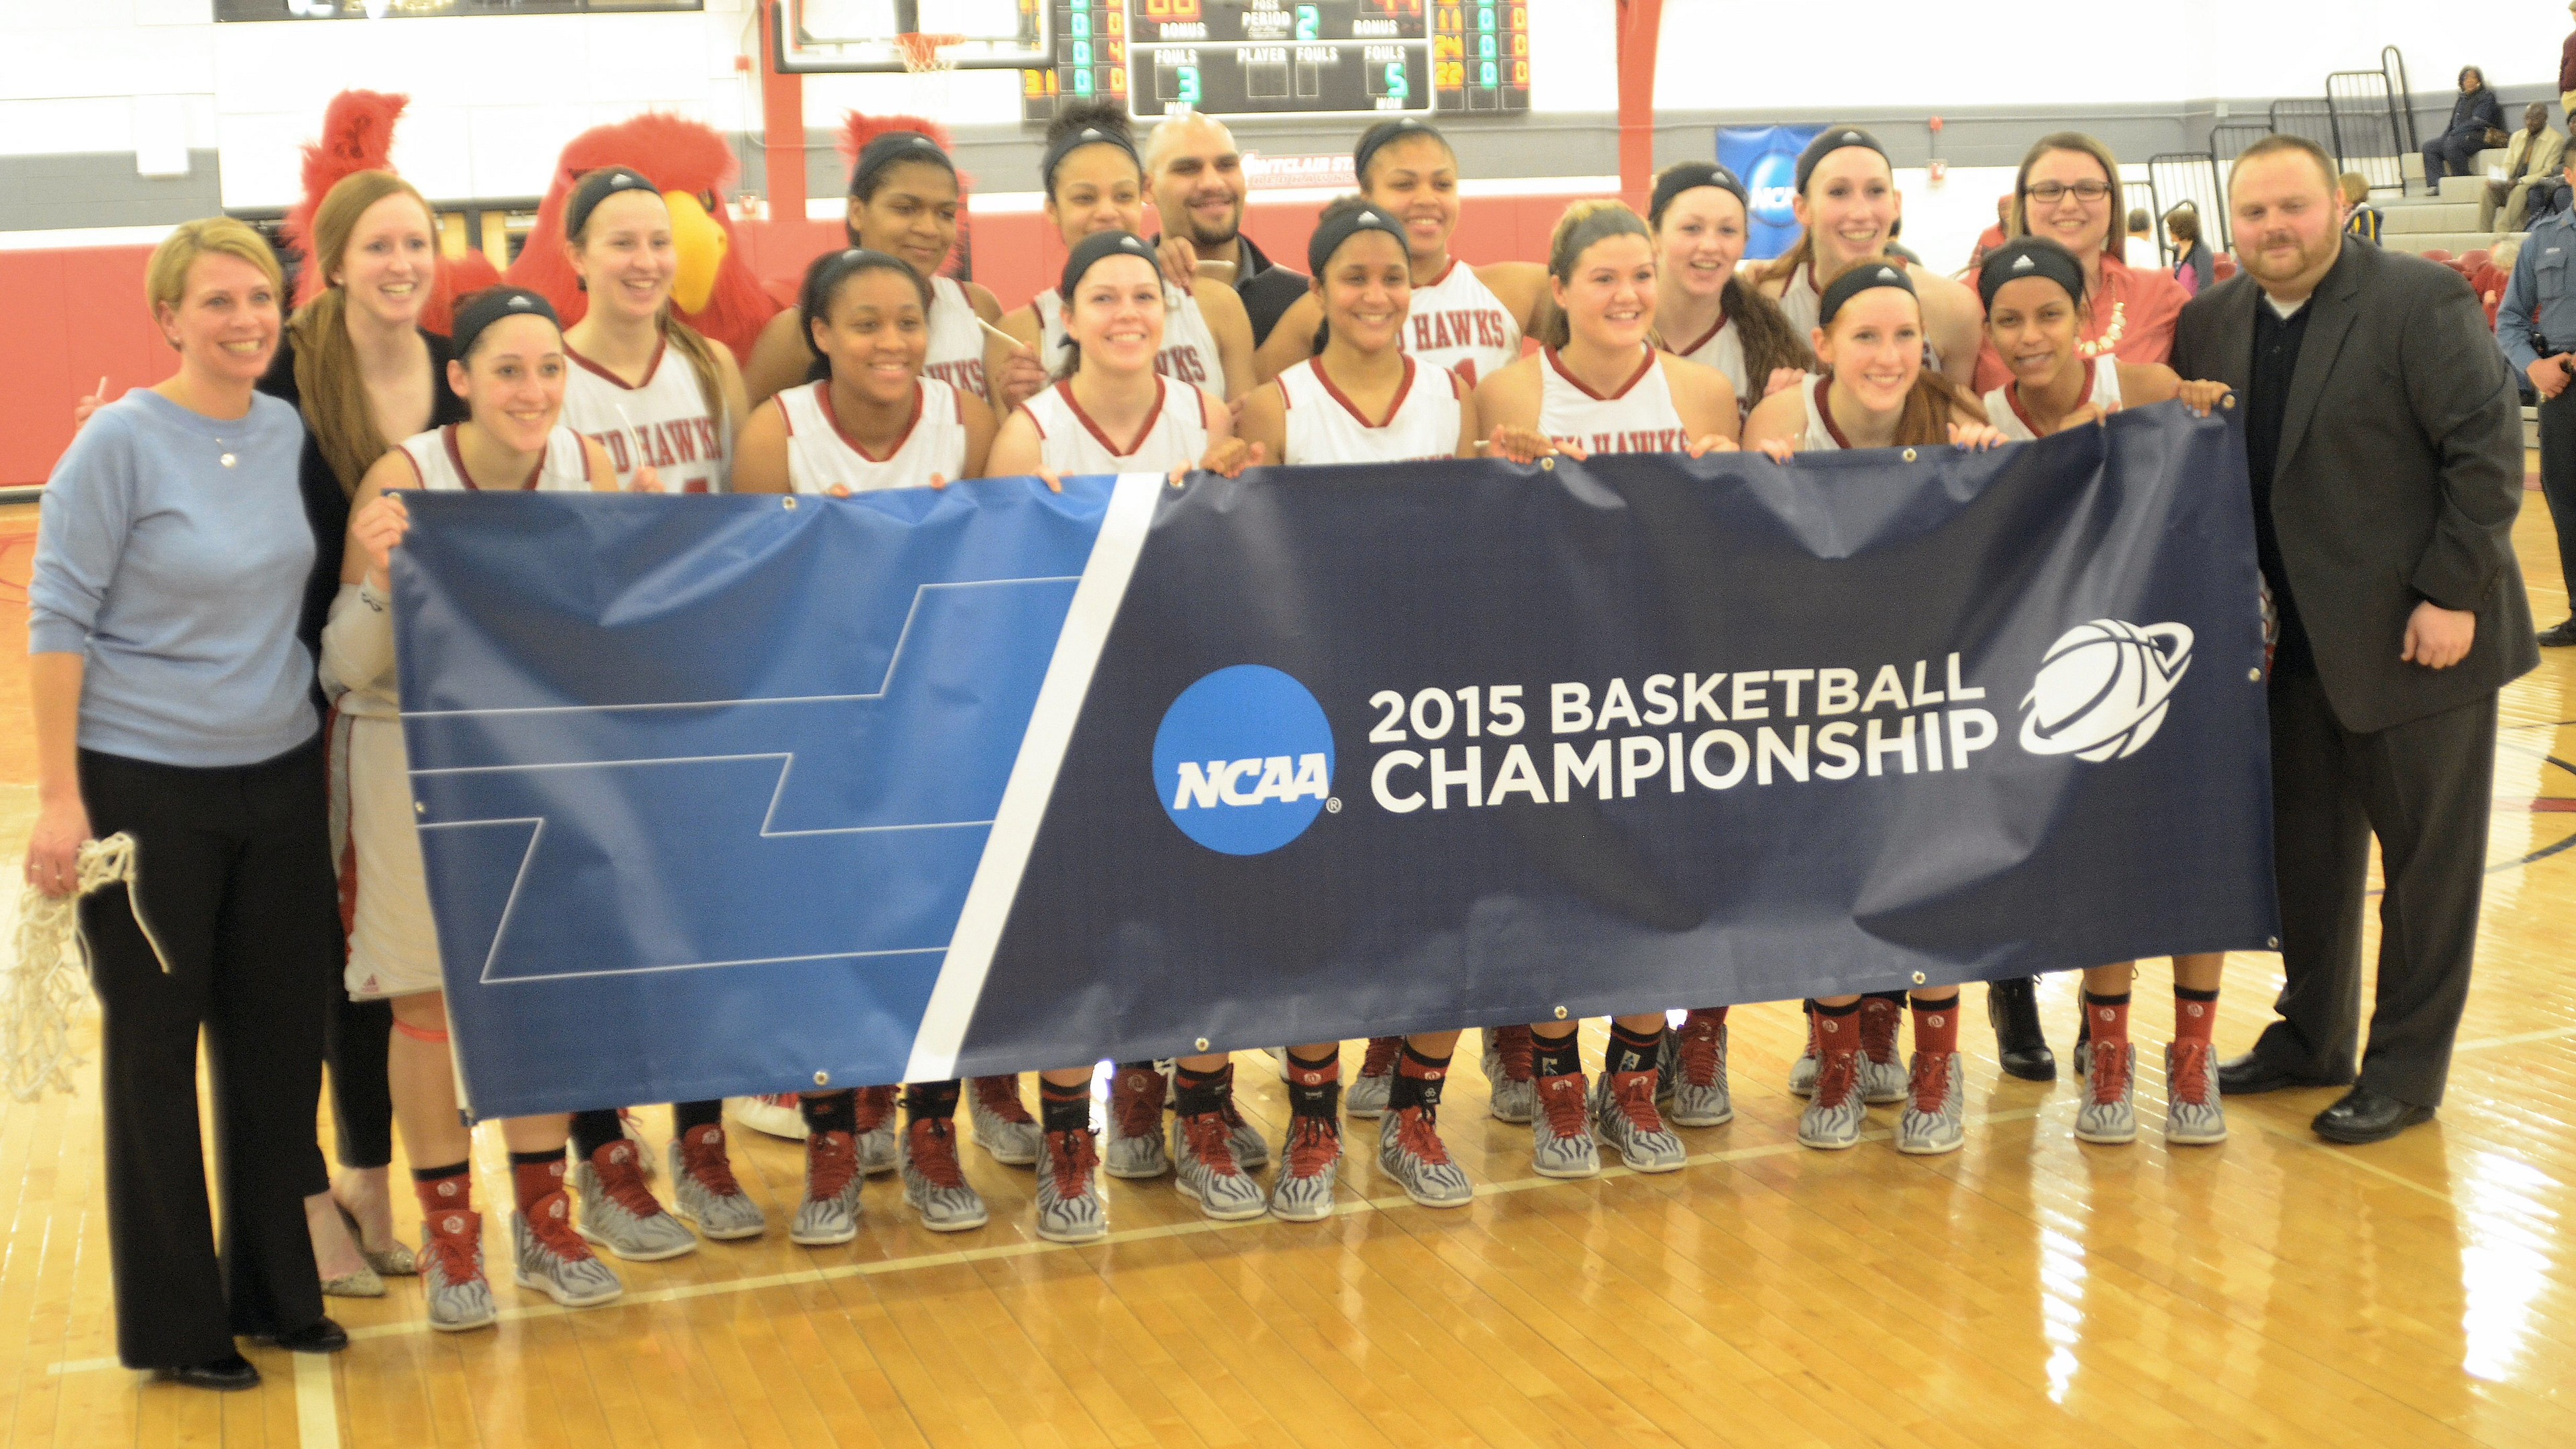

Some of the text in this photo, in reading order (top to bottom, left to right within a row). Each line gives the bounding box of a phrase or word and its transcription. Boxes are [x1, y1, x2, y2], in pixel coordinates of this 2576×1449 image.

[1241, 11, 1290, 27] PERIOD
[1296, 5, 1320, 40] 2
[1353, 19, 1398, 34] BONUS
[1160, 22, 1206, 38] BONUS
[1153, 48, 1197, 63] FOULS
[1237, 46, 1338, 62] PLAYER FOULS
[1364, 46, 1405, 60] FOULS
[1177, 66, 1201, 104] 3
[1385, 62, 1408, 97] 5
[1164, 102, 1192, 115] WON
[1376, 97, 1402, 109] WON
[1412, 309, 1506, 352] HAWKS
[1368, 652, 1986, 743] 2015 BASKETBALL
[1370, 708, 1999, 813] CHAMPIONSHIP
[1174, 752, 1329, 809] NCAA
